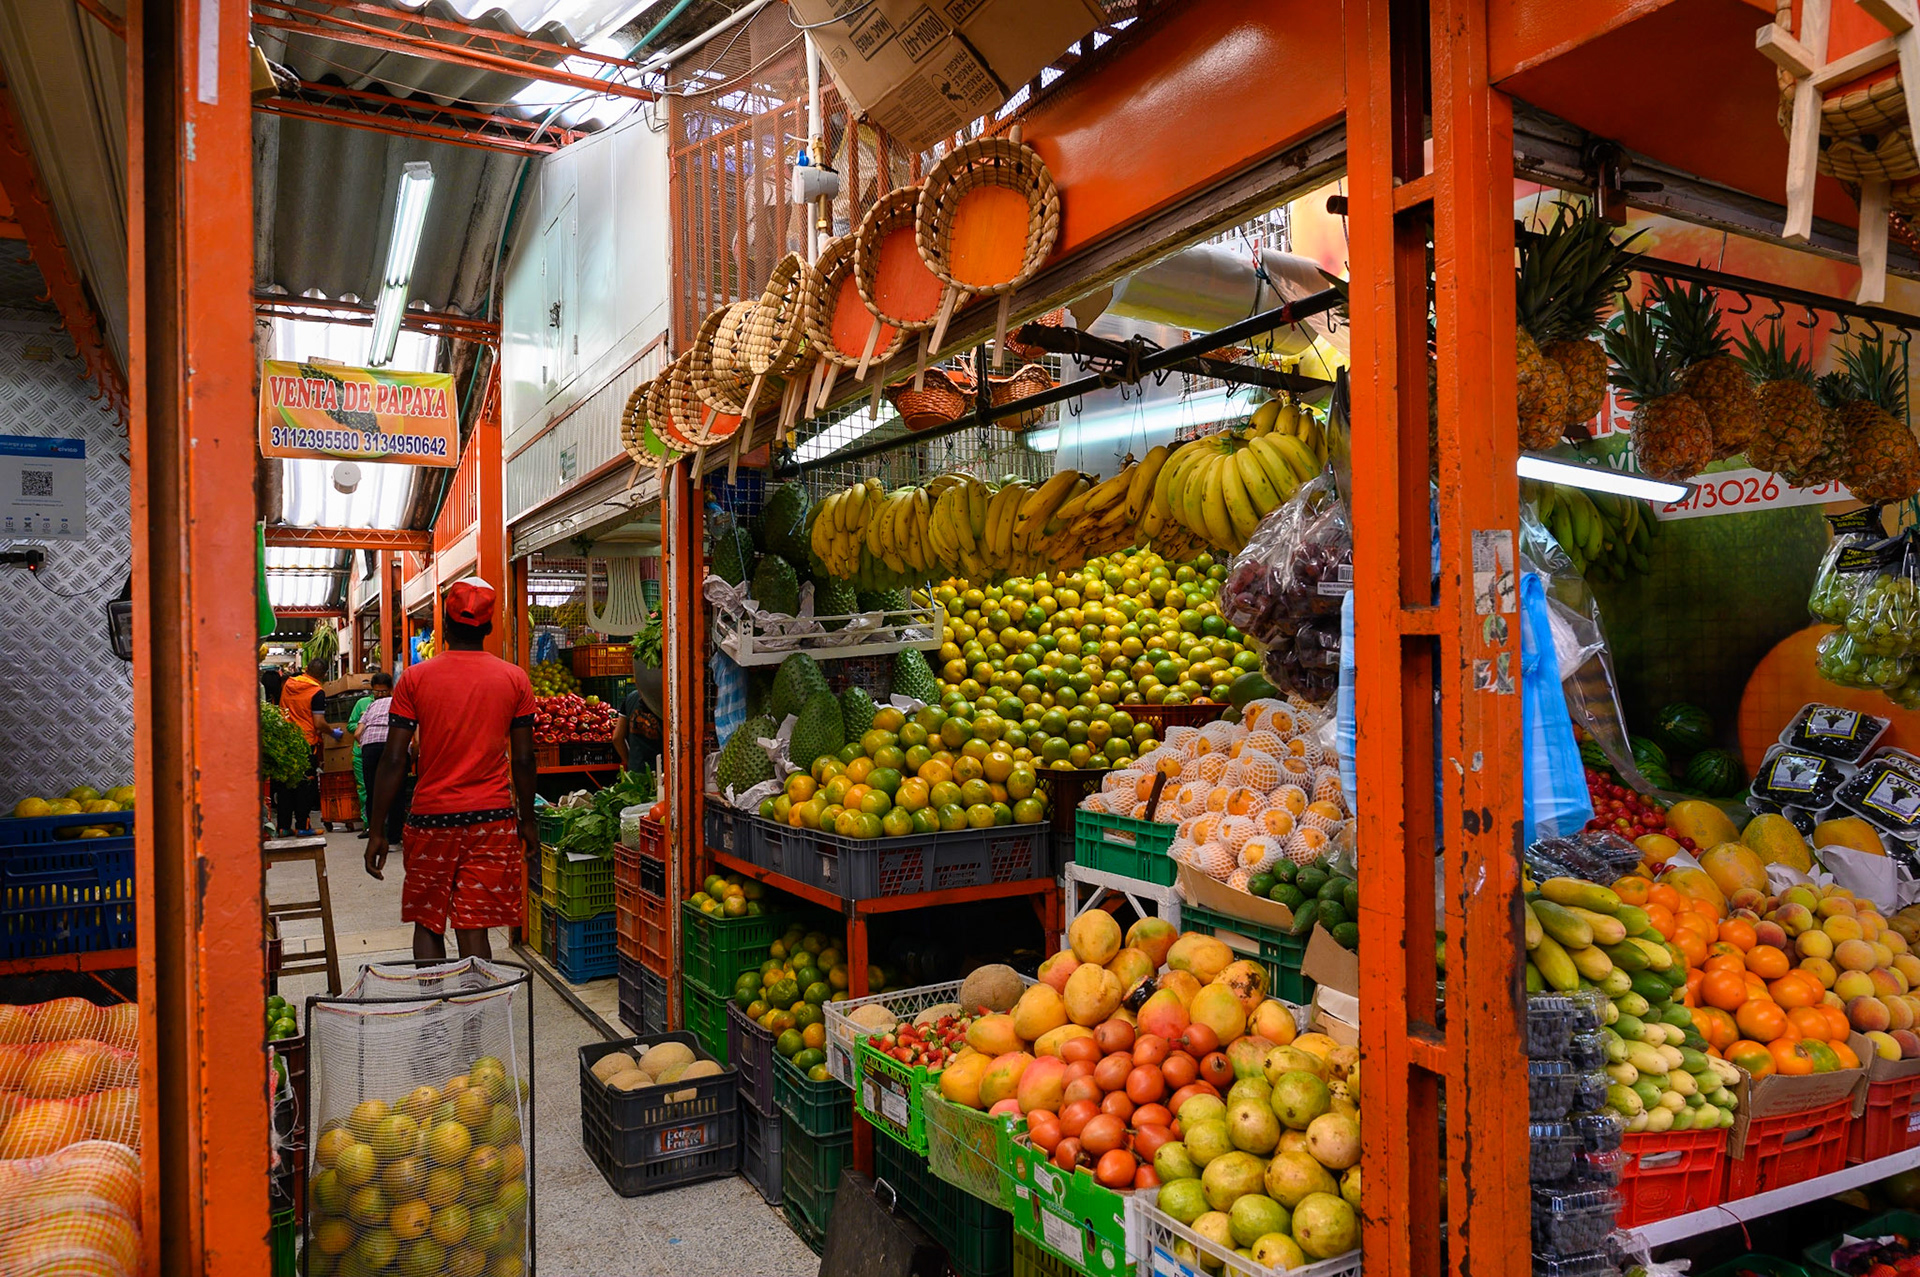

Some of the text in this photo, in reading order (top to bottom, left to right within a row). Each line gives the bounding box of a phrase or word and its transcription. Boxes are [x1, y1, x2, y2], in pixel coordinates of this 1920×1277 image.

[855, 16, 889, 53] MAC FRIES
[902, 15, 943, 57] 00004-447
[943, 48, 968, 77] FRAGILE
[951, 59, 977, 87] FRAGILE
[960, 69, 985, 97] FRAGILE
[968, 79, 993, 106] FRAGILE
[269, 376, 448, 418] VENTA DE PAPAYA
[271, 427, 447, 456] 3112395580 3134950642
[1817, 708, 1853, 719] EXTRA
